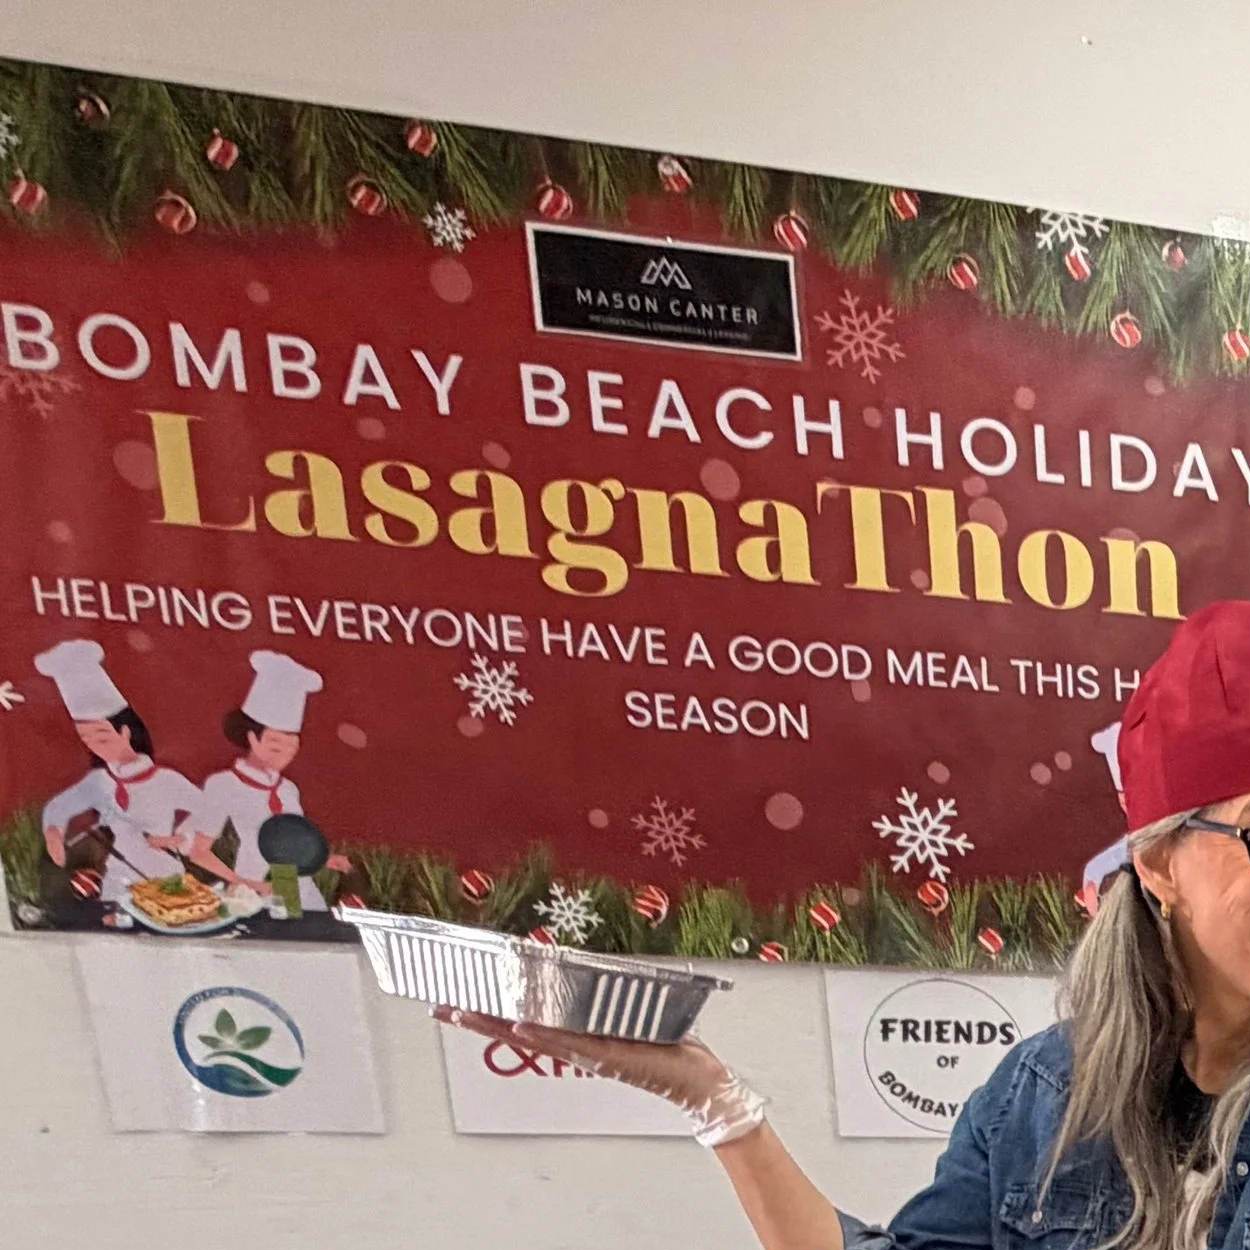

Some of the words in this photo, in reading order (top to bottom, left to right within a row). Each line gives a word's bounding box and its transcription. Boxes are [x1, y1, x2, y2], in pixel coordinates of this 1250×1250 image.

[576, 287, 659, 313] MASON
[669, 300, 759, 325] CANTER
[2, 303, 464, 416] BOMBAY
[518, 361, 845, 460] BEACH
[135, 409, 1187, 621] LasagnaThon
[31, 575, 254, 631] HELPING
[268, 596, 528, 655] EVERYONE
[540, 617, 668, 668] HAVE
[684, 632, 716, 670] A
[728, 635, 873, 682] GOOD
[886, 648, 1000, 693] MEAL
[1010, 657, 1101, 701] THIS
[624, 690, 810, 741] SEASON
[879, 1018, 1015, 1045] FRIENDS
[936, 1055, 959, 1069] OF
[878, 1071, 959, 1117] BOMBAY
